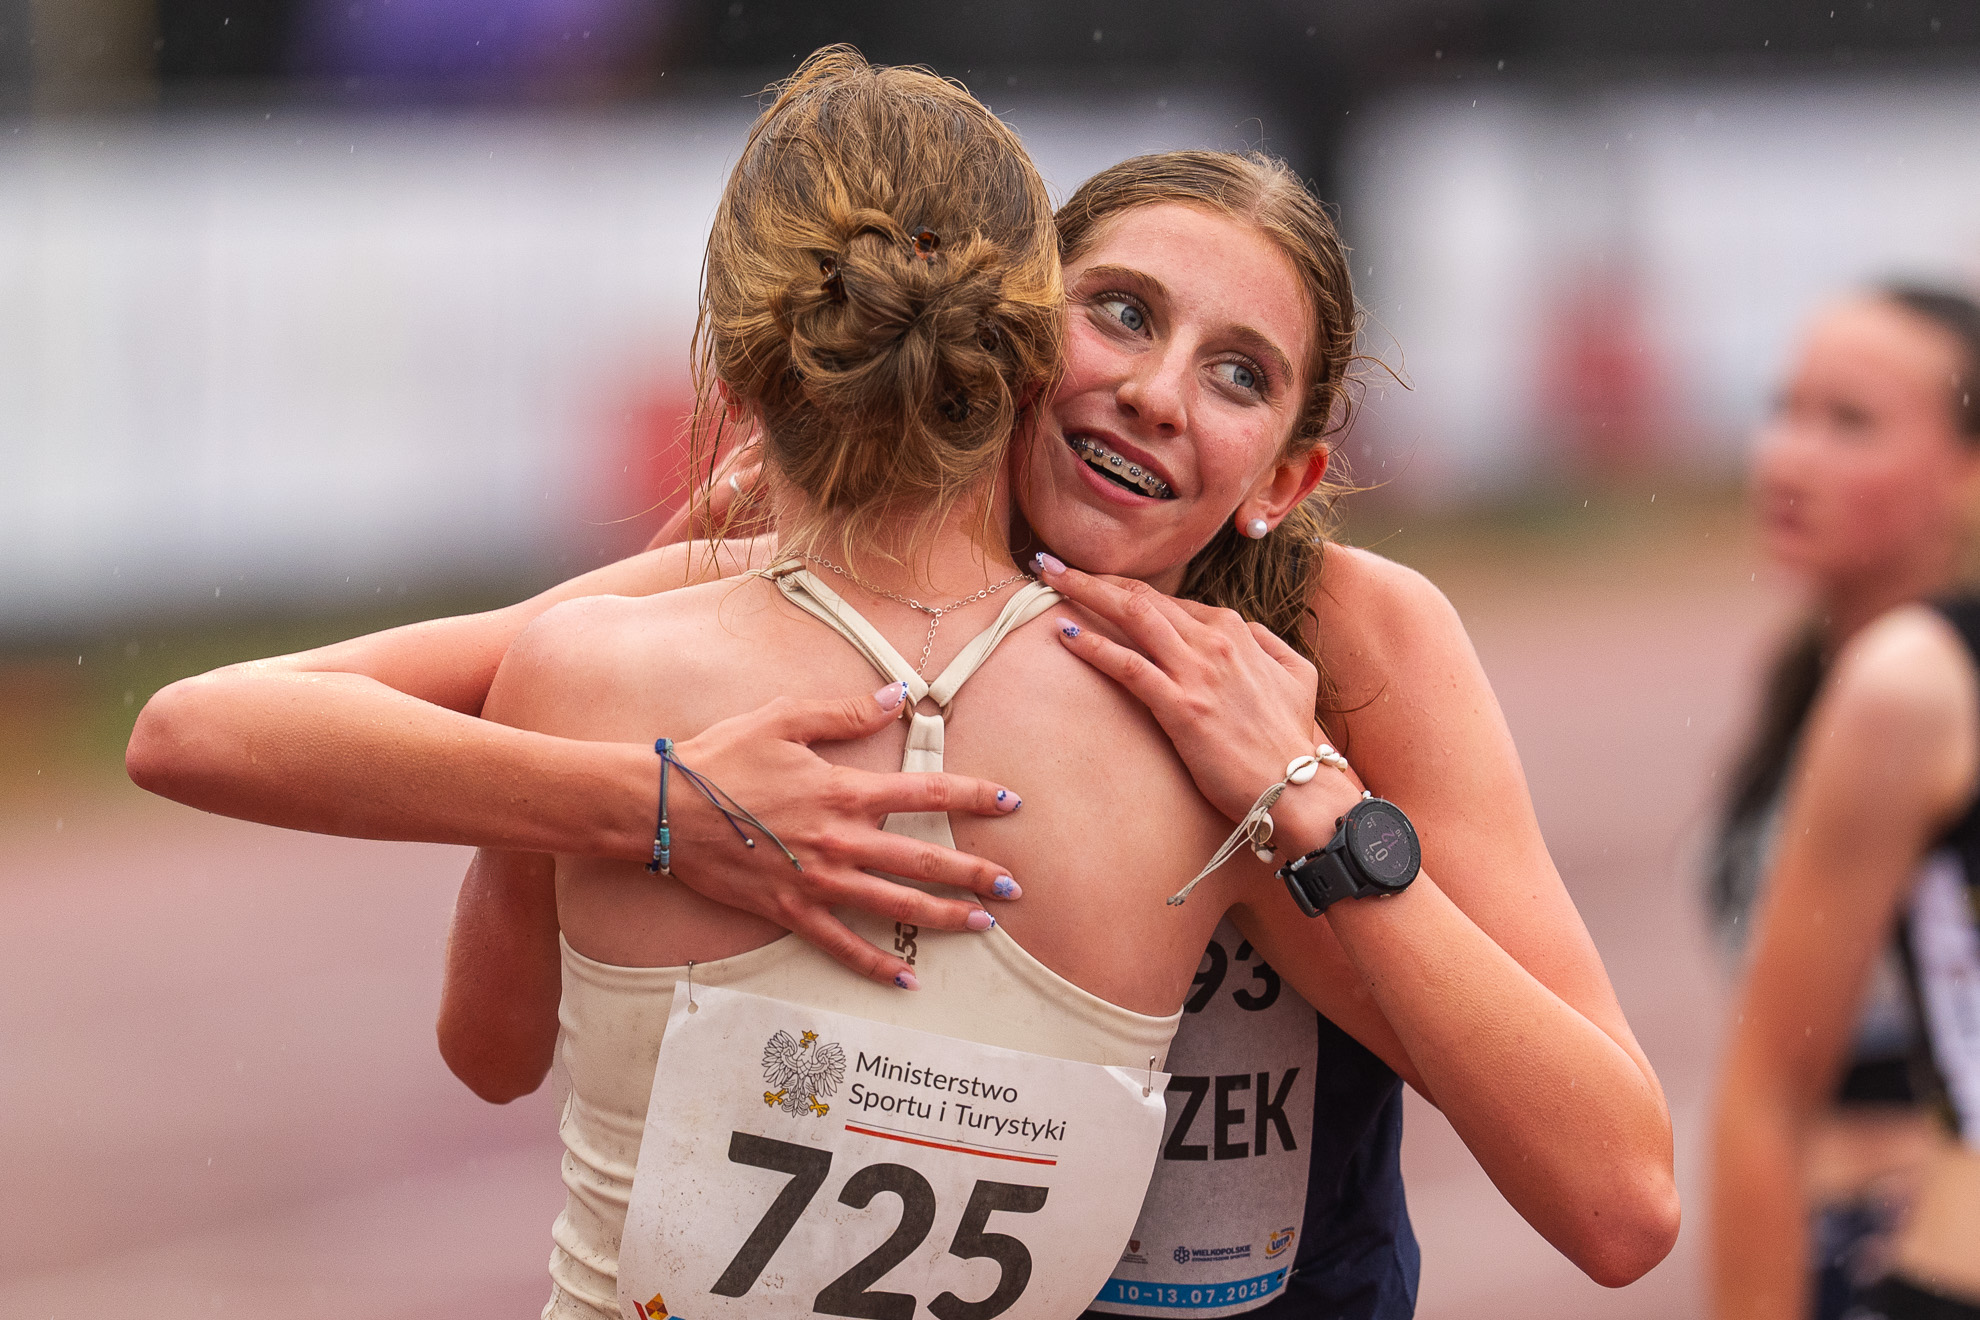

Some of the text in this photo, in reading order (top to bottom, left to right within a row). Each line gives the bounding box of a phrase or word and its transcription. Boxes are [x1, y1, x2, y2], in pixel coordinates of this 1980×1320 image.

[1369, 841, 1388, 861] 07
[855, 1051, 1018, 1103] Ministerstwo
[848, 1083, 1066, 1142] Sportu i Turystyki
[1164, 1067, 1300, 1161] ZEK
[709, 1131, 1049, 1320] 725
[1191, 1245, 1250, 1257] WIELKOPOLSKIE
[1118, 1279, 1268, 1304] 10-13.07.2025
